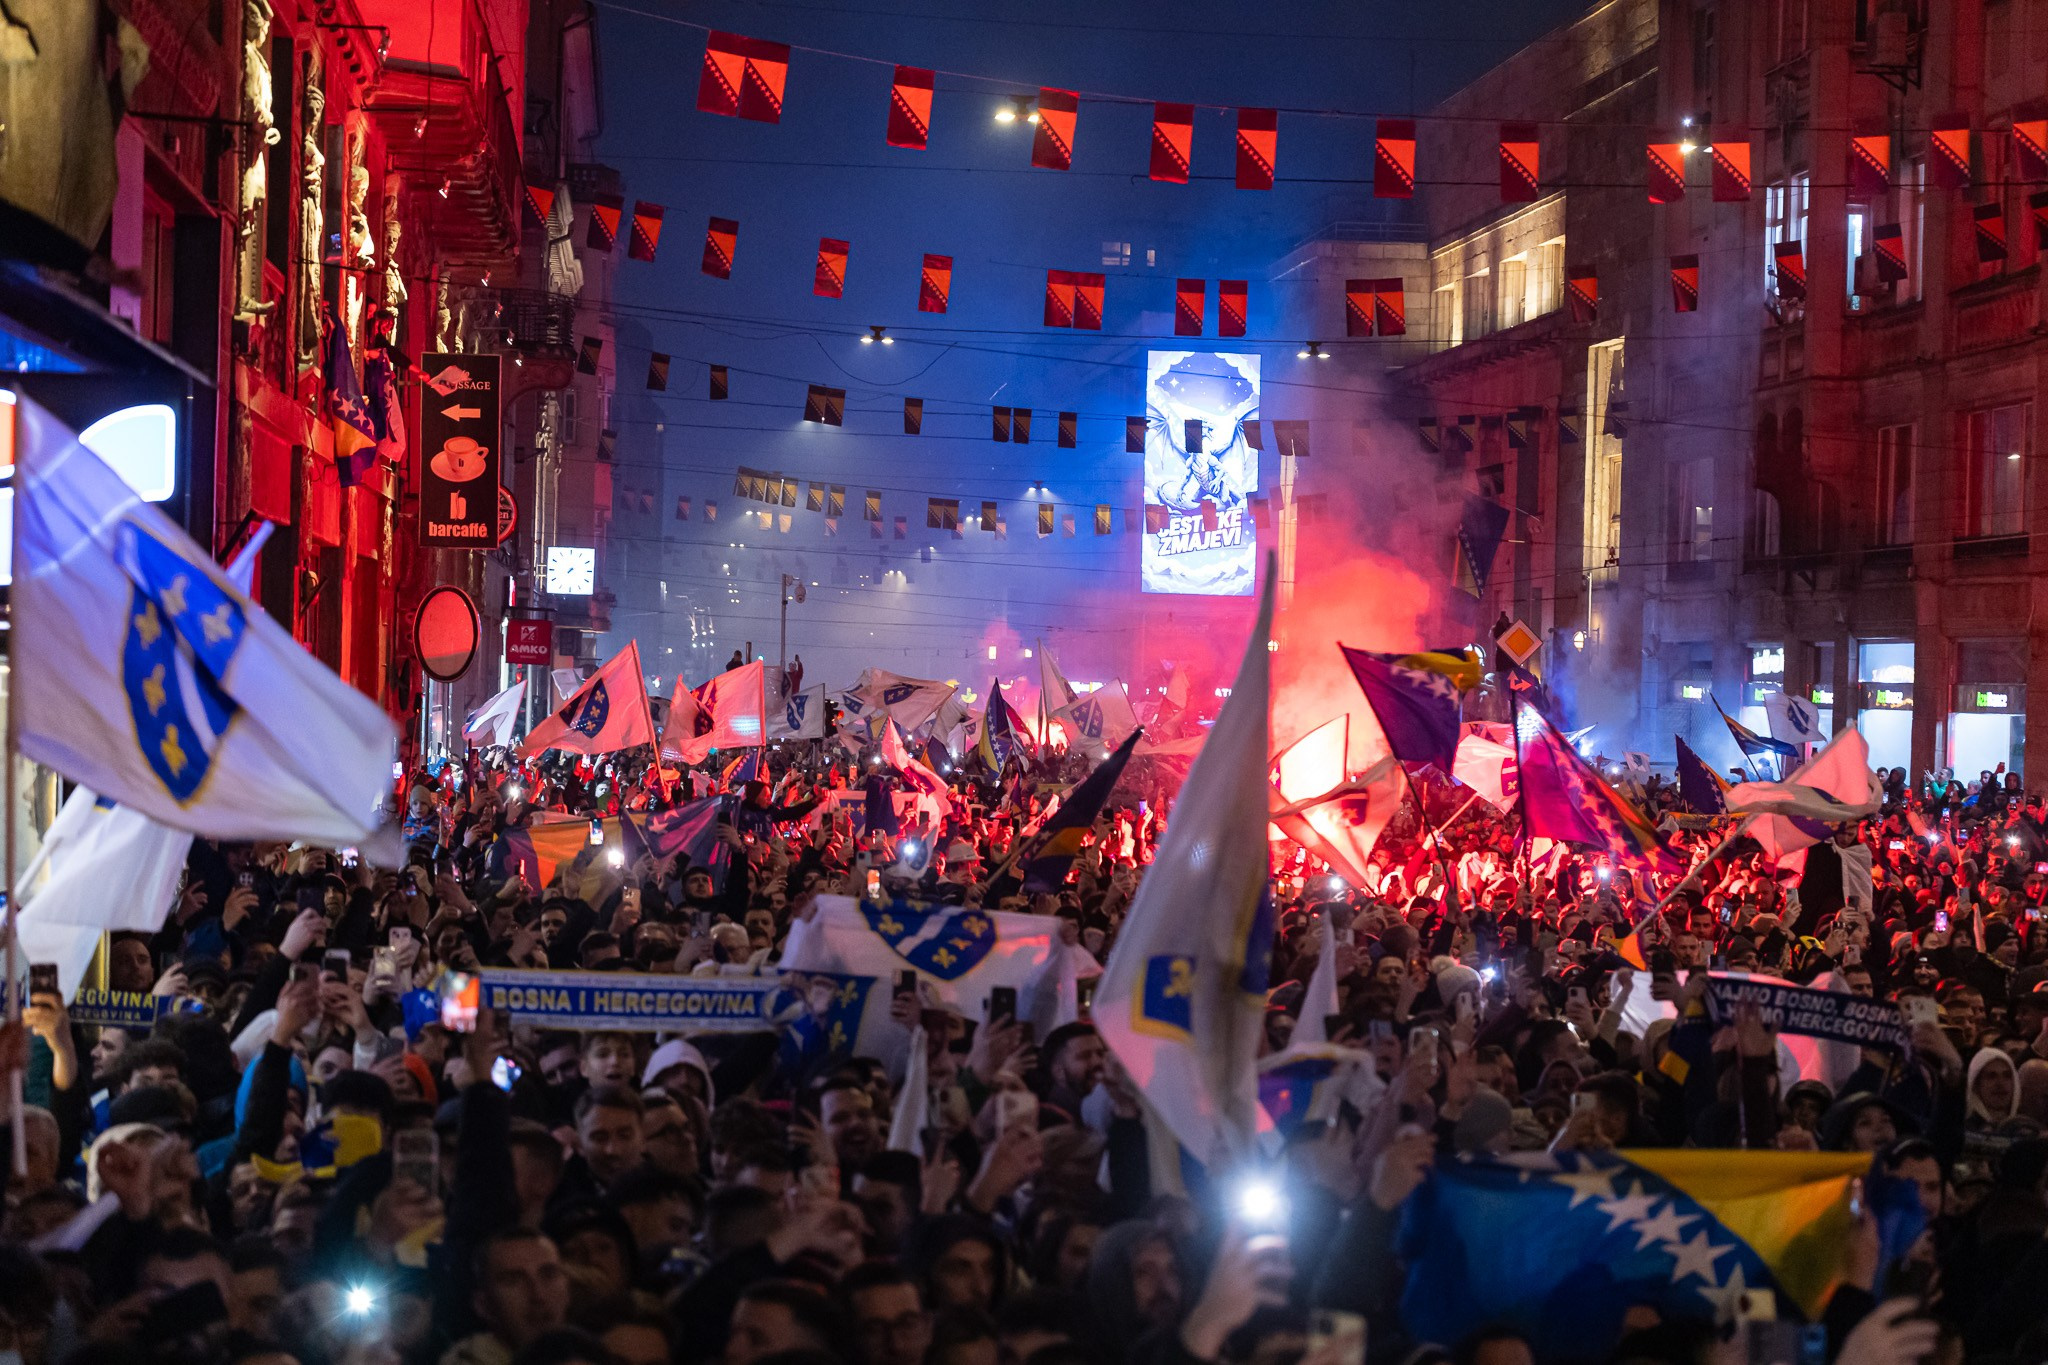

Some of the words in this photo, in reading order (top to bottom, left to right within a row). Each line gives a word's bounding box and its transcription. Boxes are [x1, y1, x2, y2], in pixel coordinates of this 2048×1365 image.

[428, 521, 488, 538] barcaffé
[1158, 526, 1243, 556] ZMAJEVI
[510, 644, 548, 655] AMKO
[75, 987, 154, 1009] EGOVINA
[492, 985, 573, 1013] BOSNA
[579, 990, 587, 1013] I
[593, 990, 755, 1016] HERCEGOVINA
